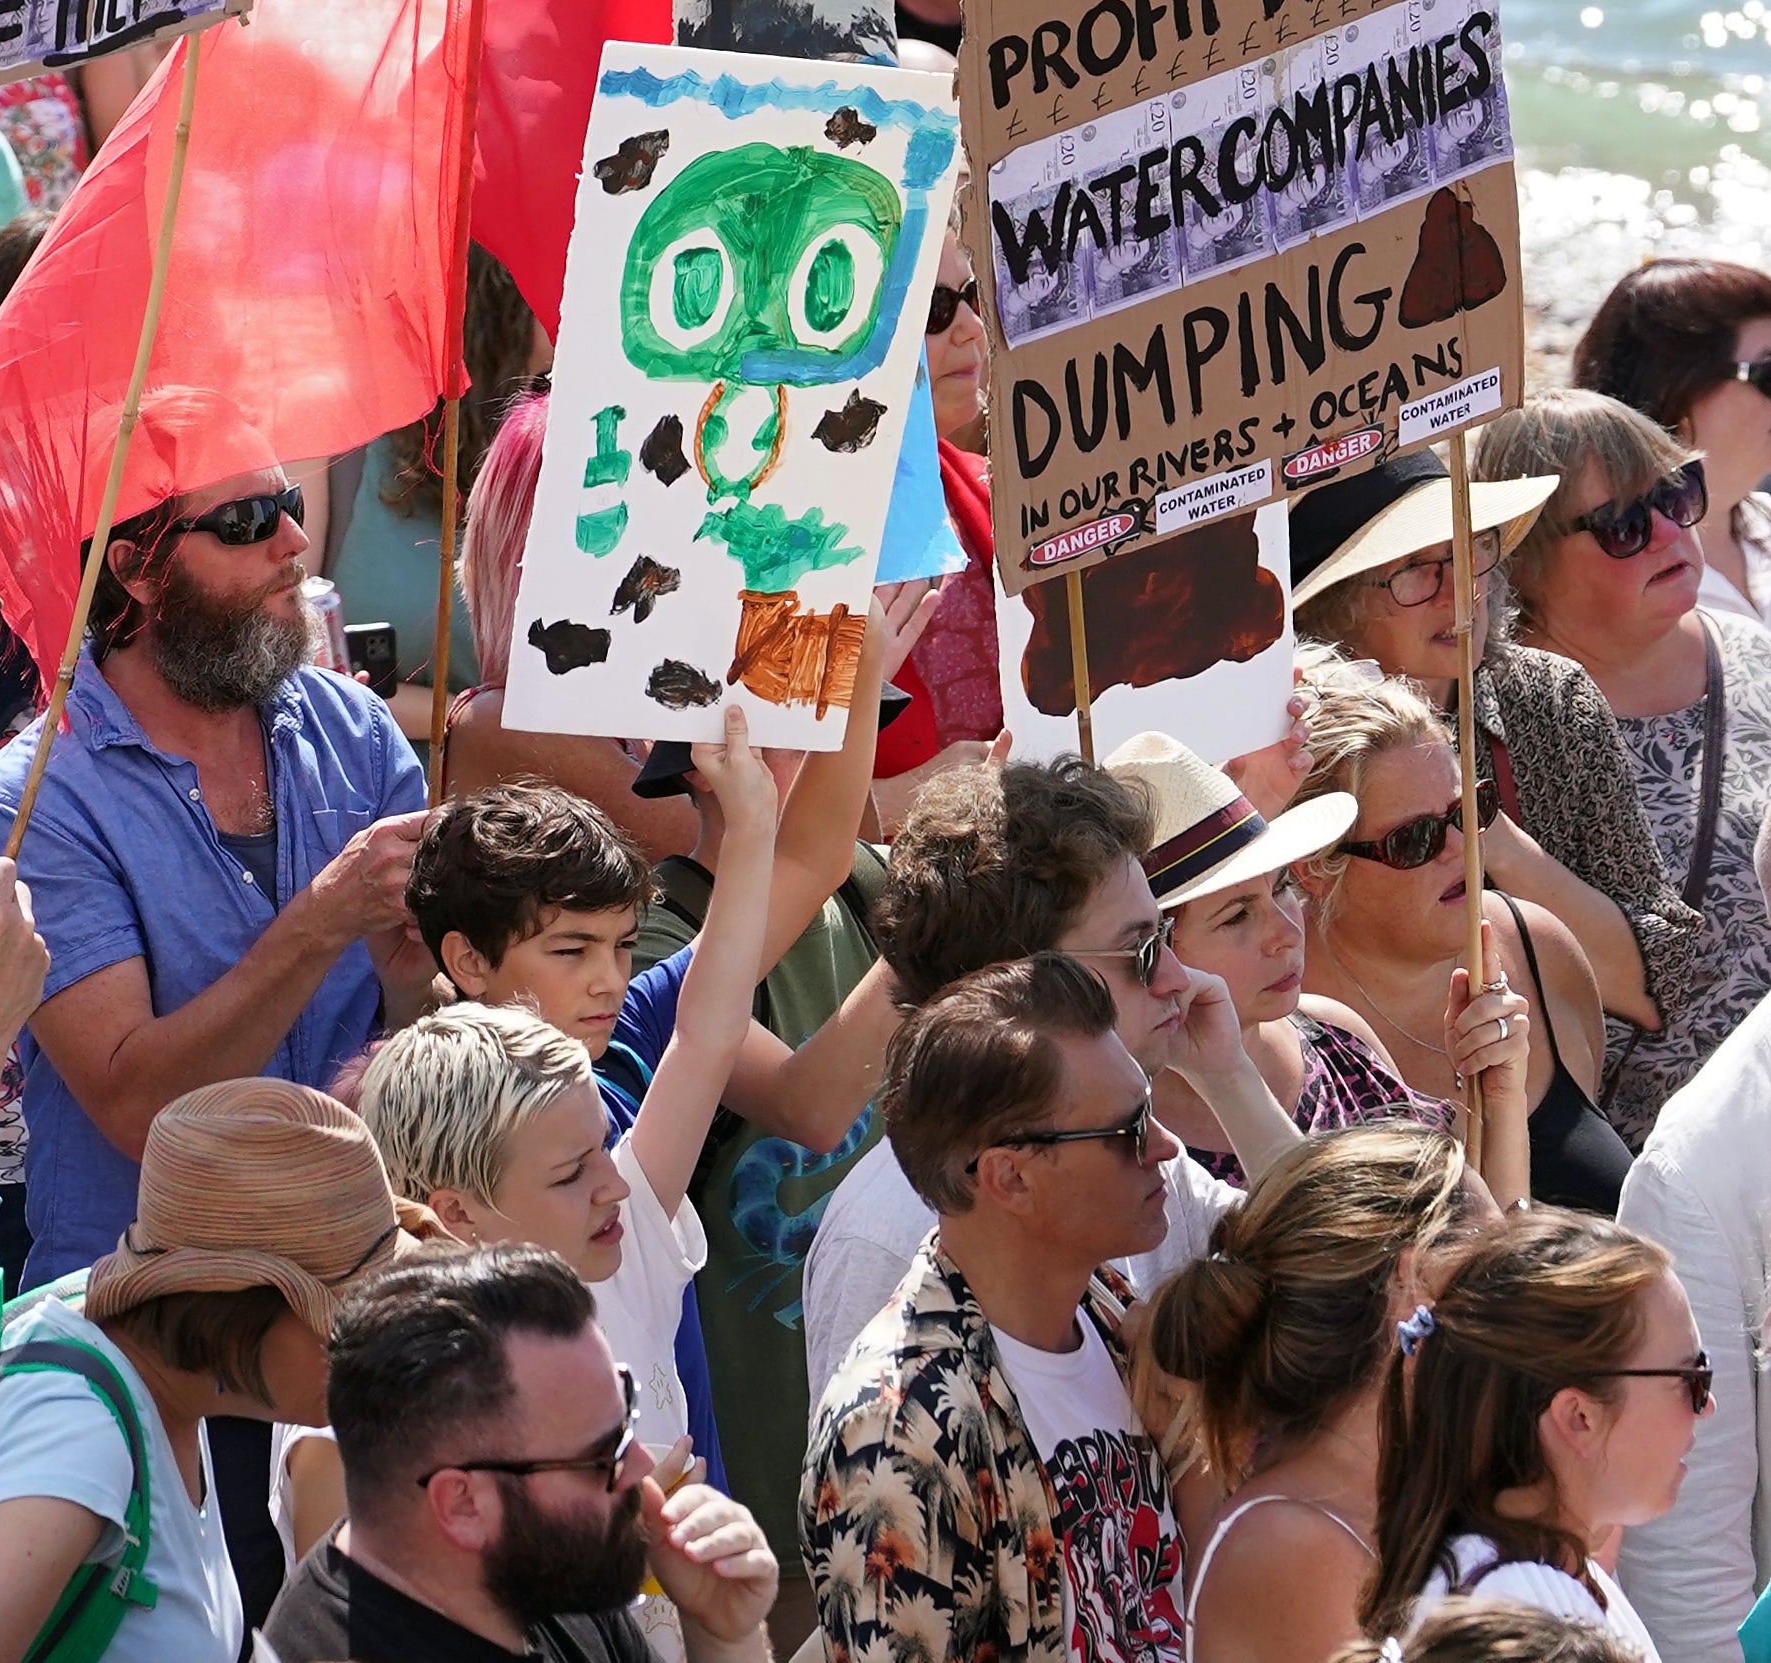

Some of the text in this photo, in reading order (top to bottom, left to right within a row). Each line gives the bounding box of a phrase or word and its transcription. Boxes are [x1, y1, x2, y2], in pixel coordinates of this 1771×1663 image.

[1012, 243, 1392, 480] DUMPING
[1401, 374, 1499, 422] CONTAMINATED
[1429, 402, 1471, 430] WATER
[1020, 501, 1049, 539] IN
[1059, 469, 1119, 520] OUR
[1129, 417, 1260, 496] RIVERS
[1310, 337, 1464, 429] OCEANS
[1295, 431, 1372, 474] DANGER
[1158, 468, 1266, 516] CONTAMINATED
[1187, 494, 1236, 521] WATER
[1043, 517, 1122, 563] DANGER
